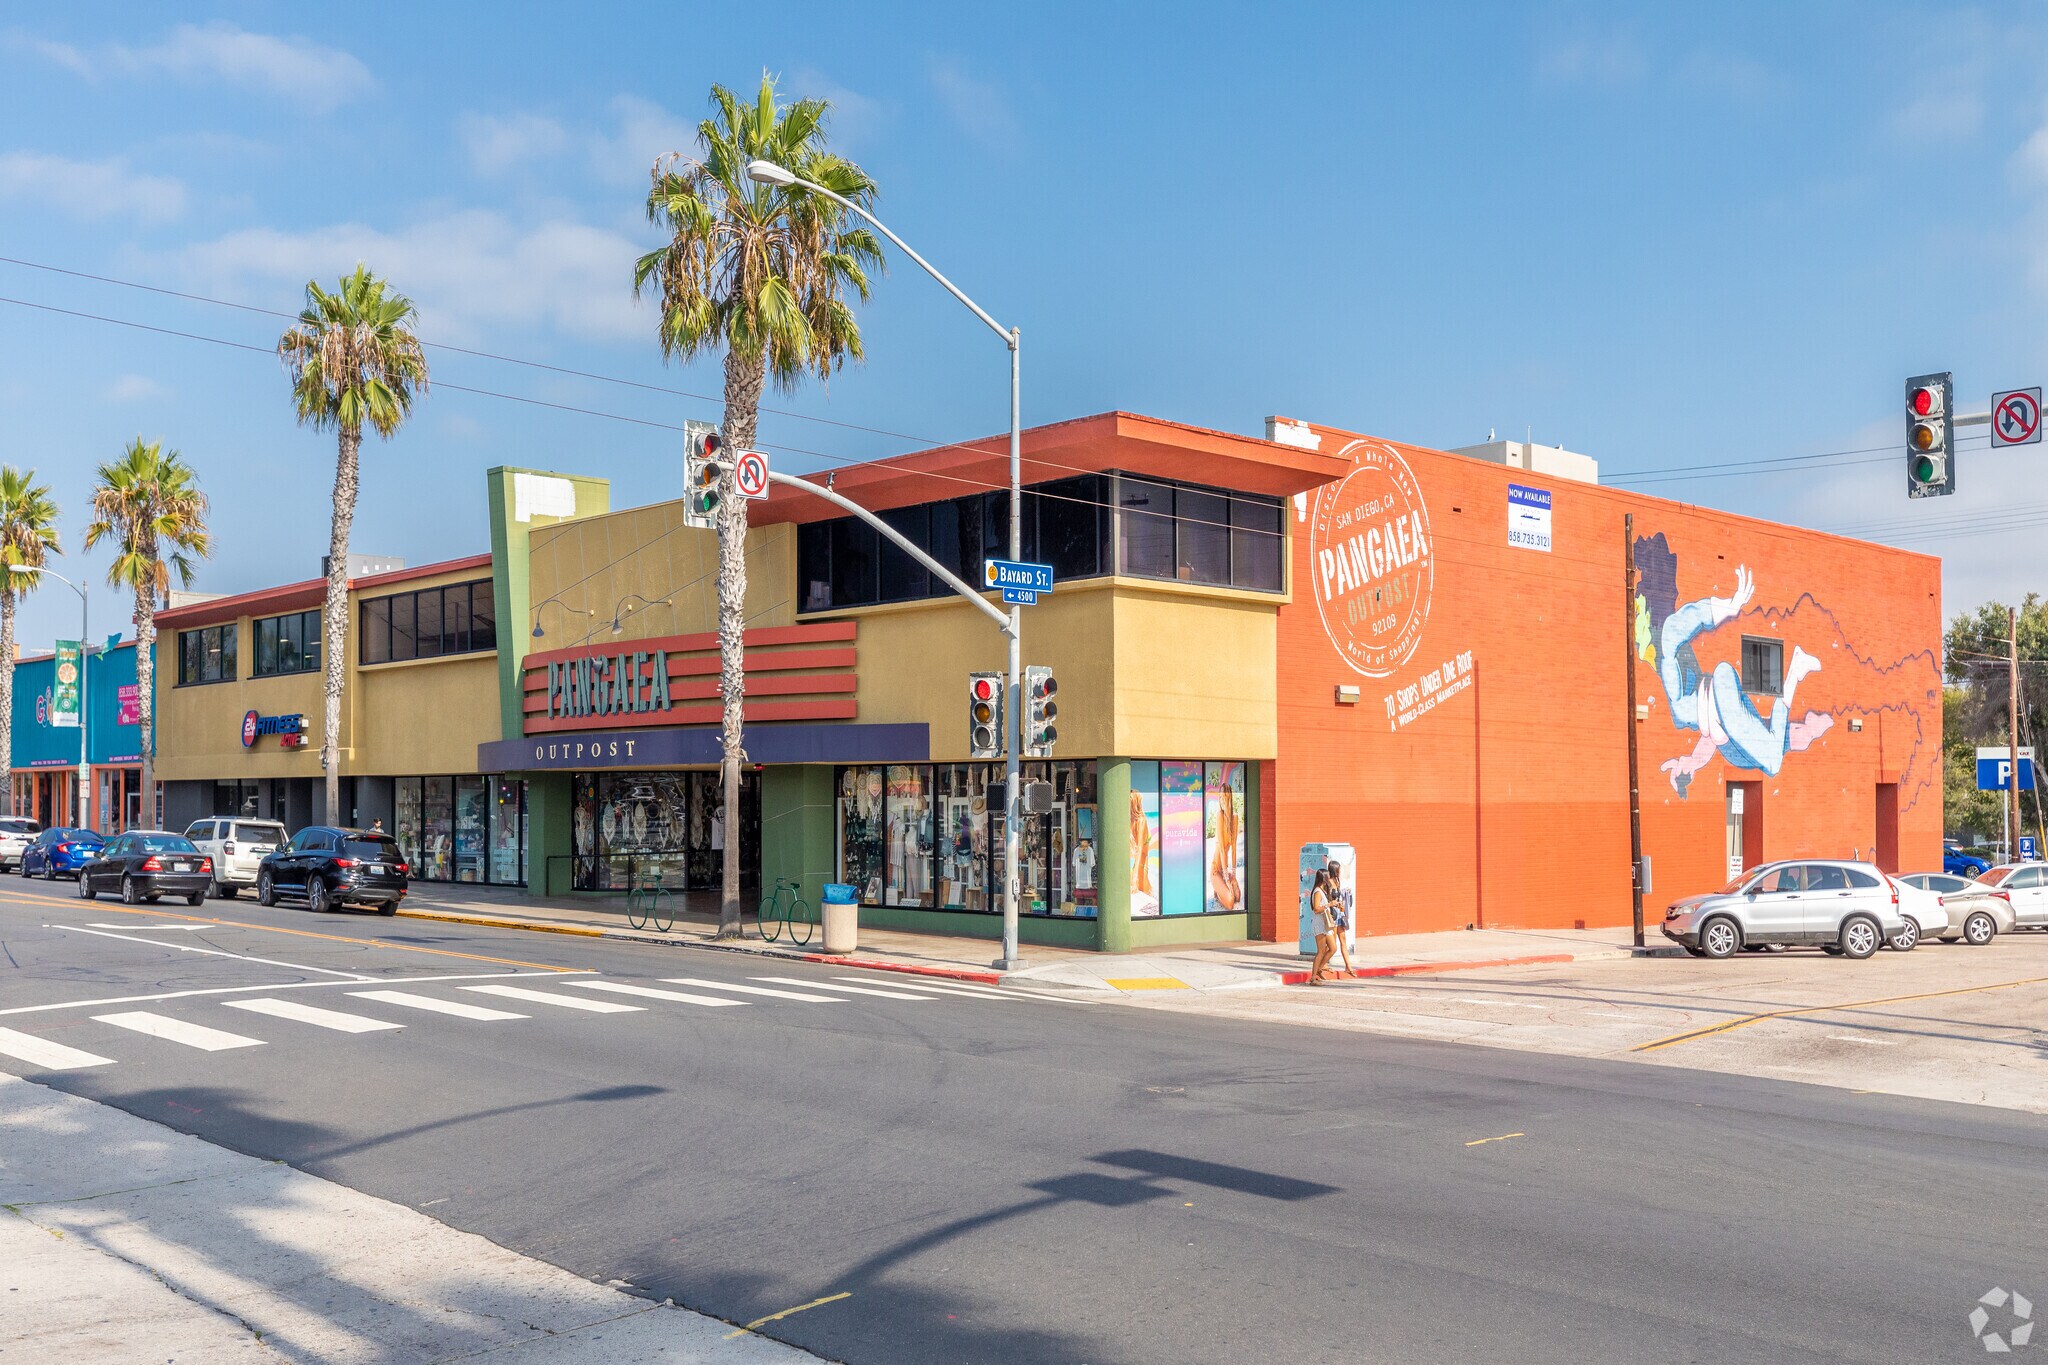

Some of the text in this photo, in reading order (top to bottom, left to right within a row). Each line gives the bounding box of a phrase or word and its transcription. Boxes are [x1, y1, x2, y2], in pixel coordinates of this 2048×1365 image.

[1366, 451, 1394, 470] Whole
[1398, 471, 1413, 496] New
[1509, 488, 1551, 504] NOW AVAILABLE
[1336, 511, 1352, 529] SAN
[1508, 530, 1550, 548] 858.735.3121
[1319, 510, 1428, 602] PANGAEA
[1017, 590, 1034, 602] 4500
[1347, 572, 1409, 625] OUTPOST
[1372, 613, 1397, 637] 92109
[1348, 641, 1371, 664] World
[1376, 654, 1385, 664] of
[547, 650, 672, 720] PANGAEA
[1397, 683, 1419, 711] SHOPS
[1420, 669, 1442, 697] UNDER
[1442, 660, 1457, 684] ONE
[1456, 650, 1473, 676] ROOF
[1391, 719, 1397, 733] A
[1436, 674, 1472, 704] MARKETPLACE
[245, 718, 256, 732] 24
[256, 714, 303, 736] FITNESS
[536, 740, 635, 761] OUTPOST
[1997, 761, 2011, 786] P
